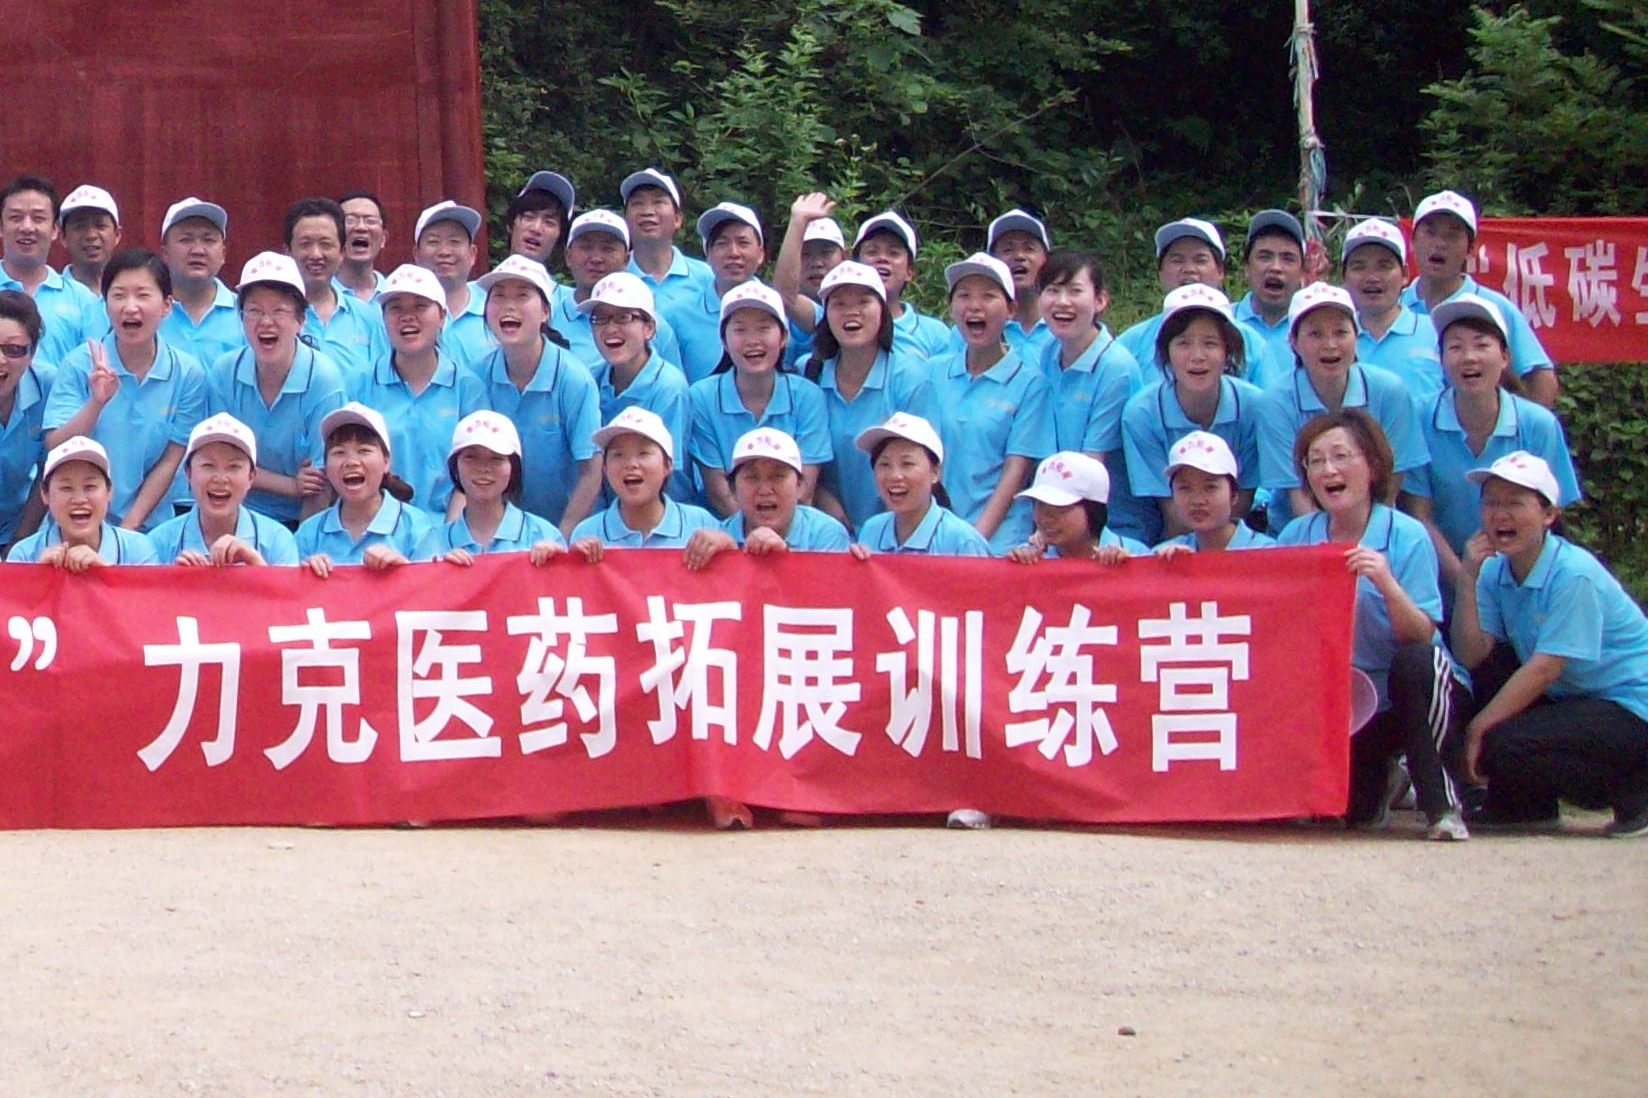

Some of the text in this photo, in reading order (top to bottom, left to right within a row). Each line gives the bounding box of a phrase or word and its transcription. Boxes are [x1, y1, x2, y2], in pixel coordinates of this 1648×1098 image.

[137, 595, 1251, 772] 力克医药拓展训练营
